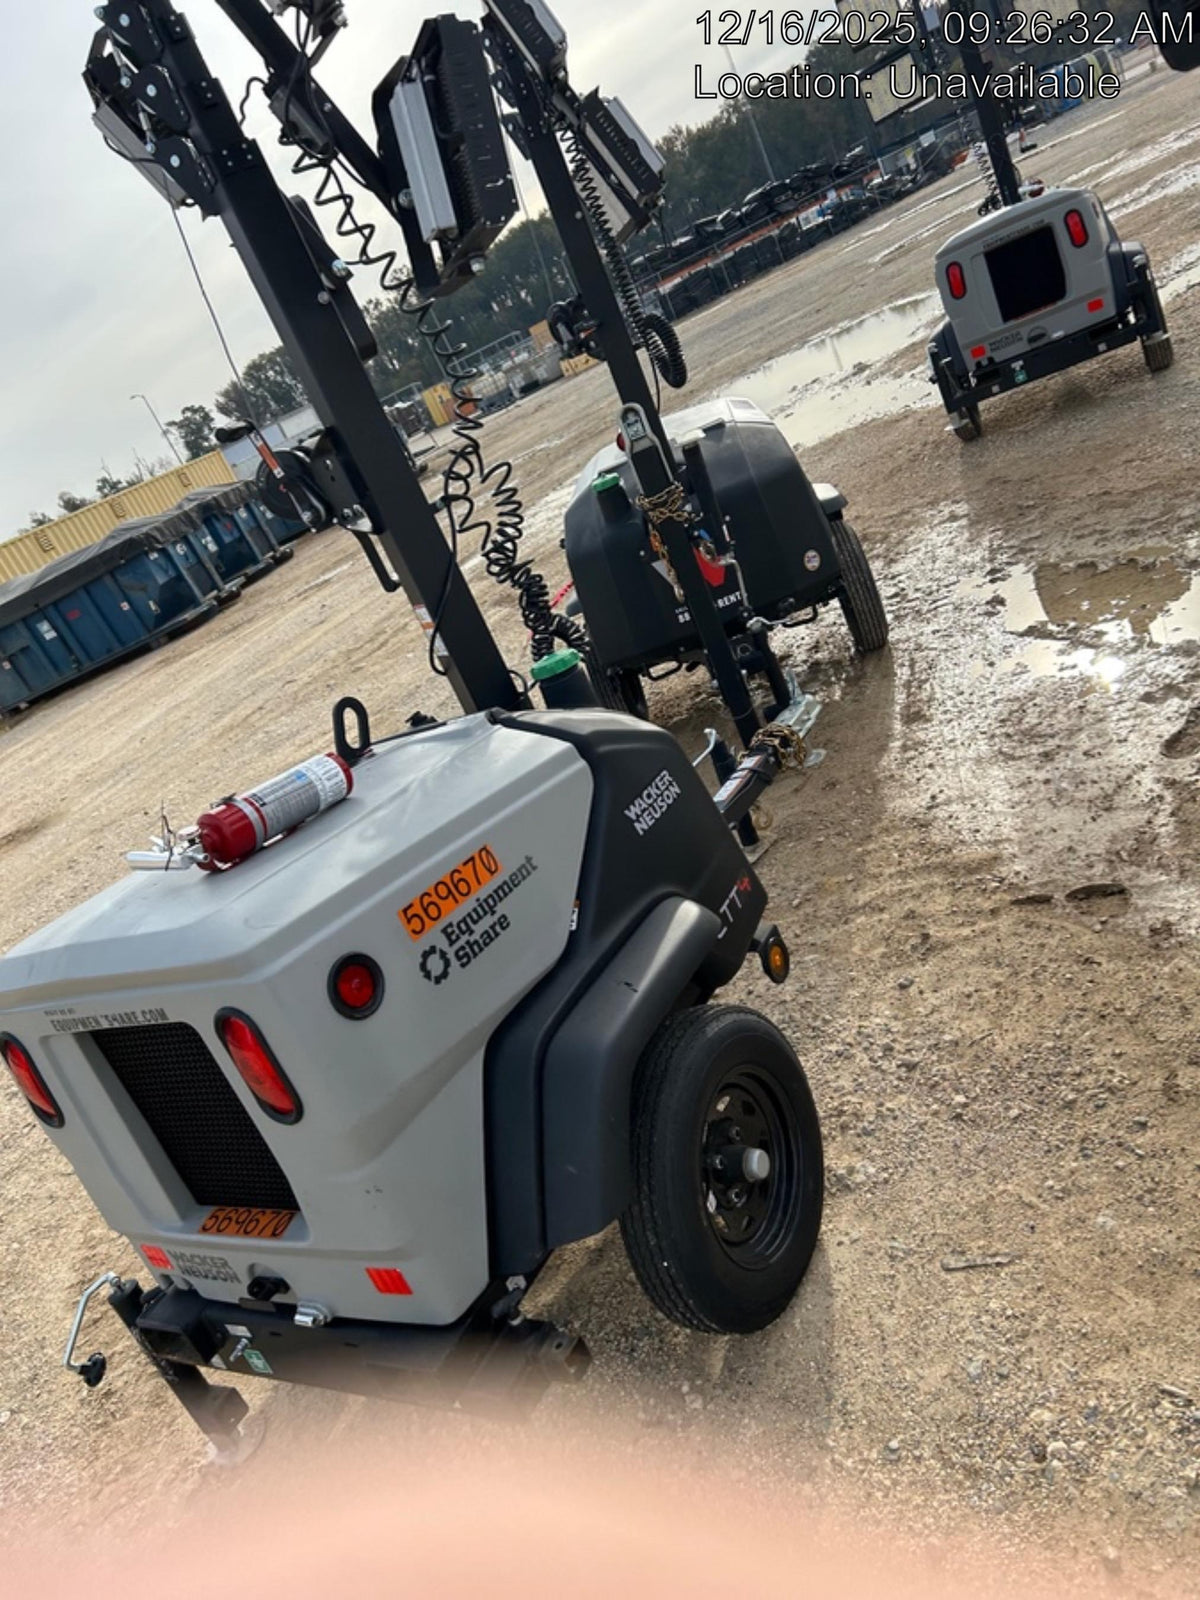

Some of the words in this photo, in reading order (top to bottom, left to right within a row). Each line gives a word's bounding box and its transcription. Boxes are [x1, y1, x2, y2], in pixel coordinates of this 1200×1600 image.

[623, 769, 673, 820] WACKER
[633, 781, 681, 835] NEUSON
[401, 845, 499, 936] 569670
[440, 854, 538, 947] Equipment
[454, 913, 511, 969] Share
[202, 1207, 296, 1237] 569670
